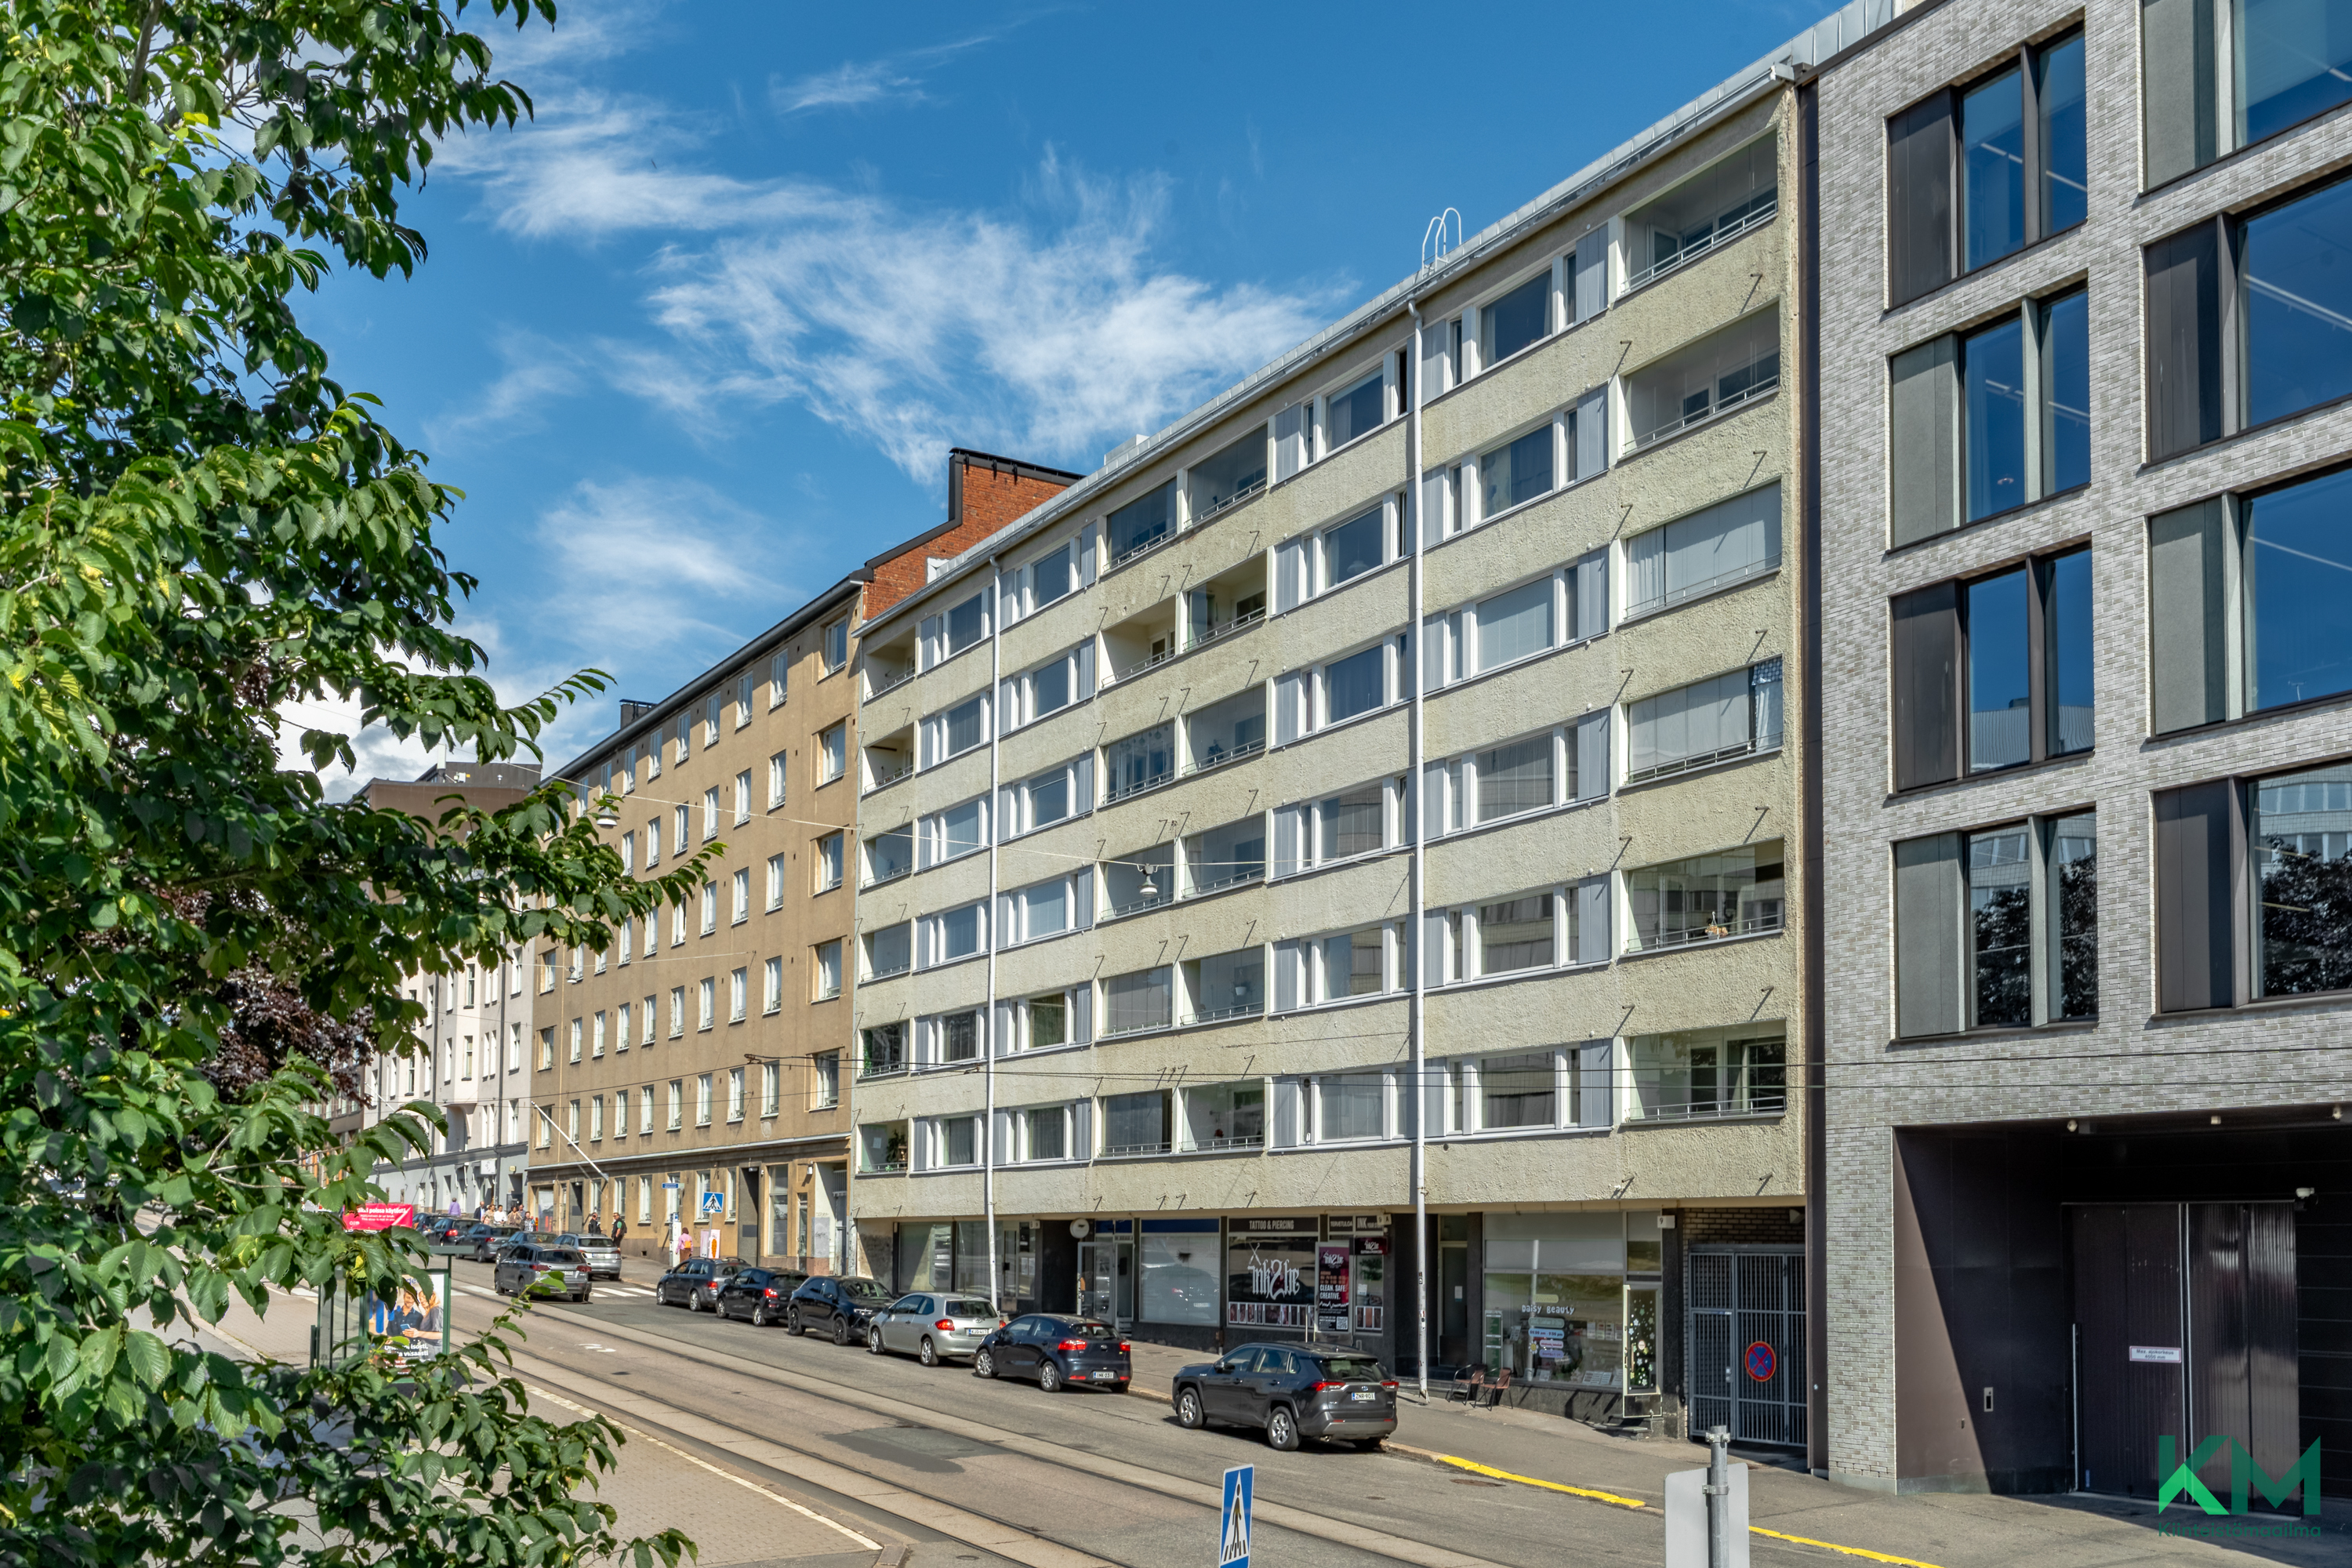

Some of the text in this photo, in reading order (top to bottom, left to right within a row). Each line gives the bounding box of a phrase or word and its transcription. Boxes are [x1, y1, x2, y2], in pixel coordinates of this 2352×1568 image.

[1249, 1220, 1294, 1229] TATTOO & PIERCING
[1357, 1217, 1367, 1229] INK
[1522, 1305, 1574, 1315] Daisy Beauty
